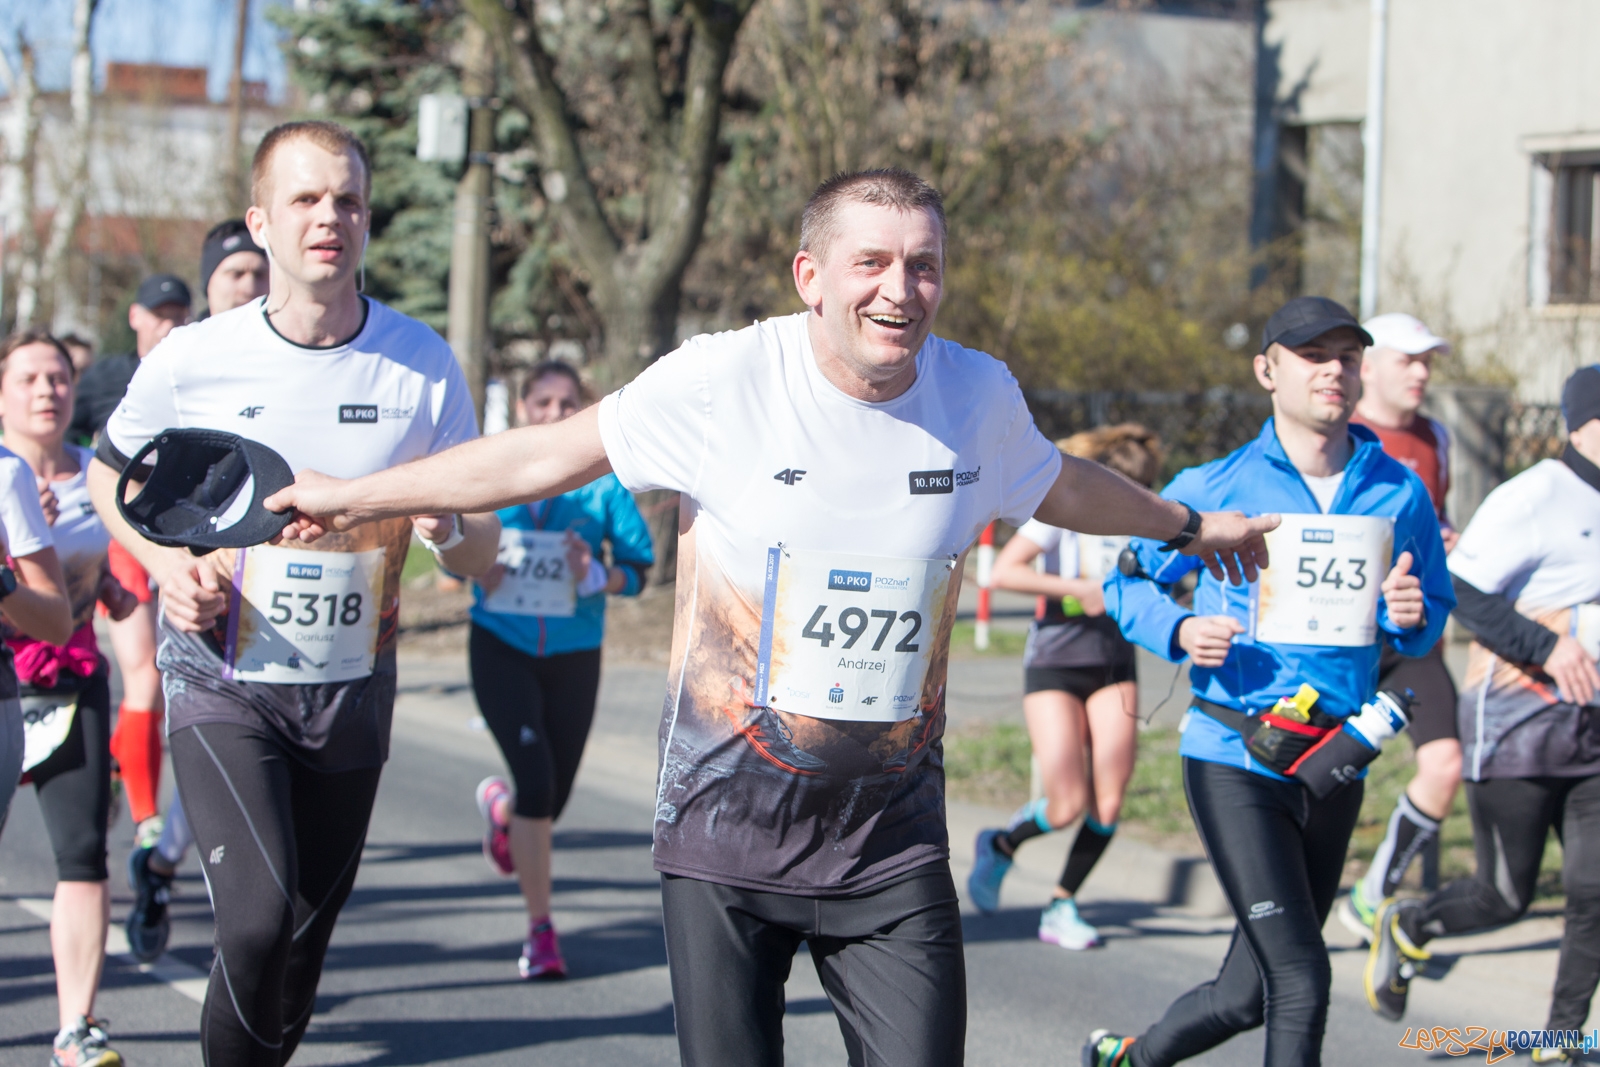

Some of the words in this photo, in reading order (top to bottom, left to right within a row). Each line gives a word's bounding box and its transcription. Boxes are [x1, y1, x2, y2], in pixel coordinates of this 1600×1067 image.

[238, 406, 264, 418] 4F
[355, 409, 376, 419] PKO
[773, 468, 807, 486] 4F
[913, 477, 928, 488] 10.
[929, 476, 951, 488] PKO
[301, 567, 321, 577] PKO
[1296, 556, 1367, 590] 543
[833, 575, 846, 585] 10.
[847, 576, 868, 587] PKO
[268, 591, 362, 626] 5318
[801, 605, 922, 652] 4972
[295, 631, 335, 642] Dariusz
[837, 657, 887, 674] Andrzej
[861, 696, 878, 705] 4F
